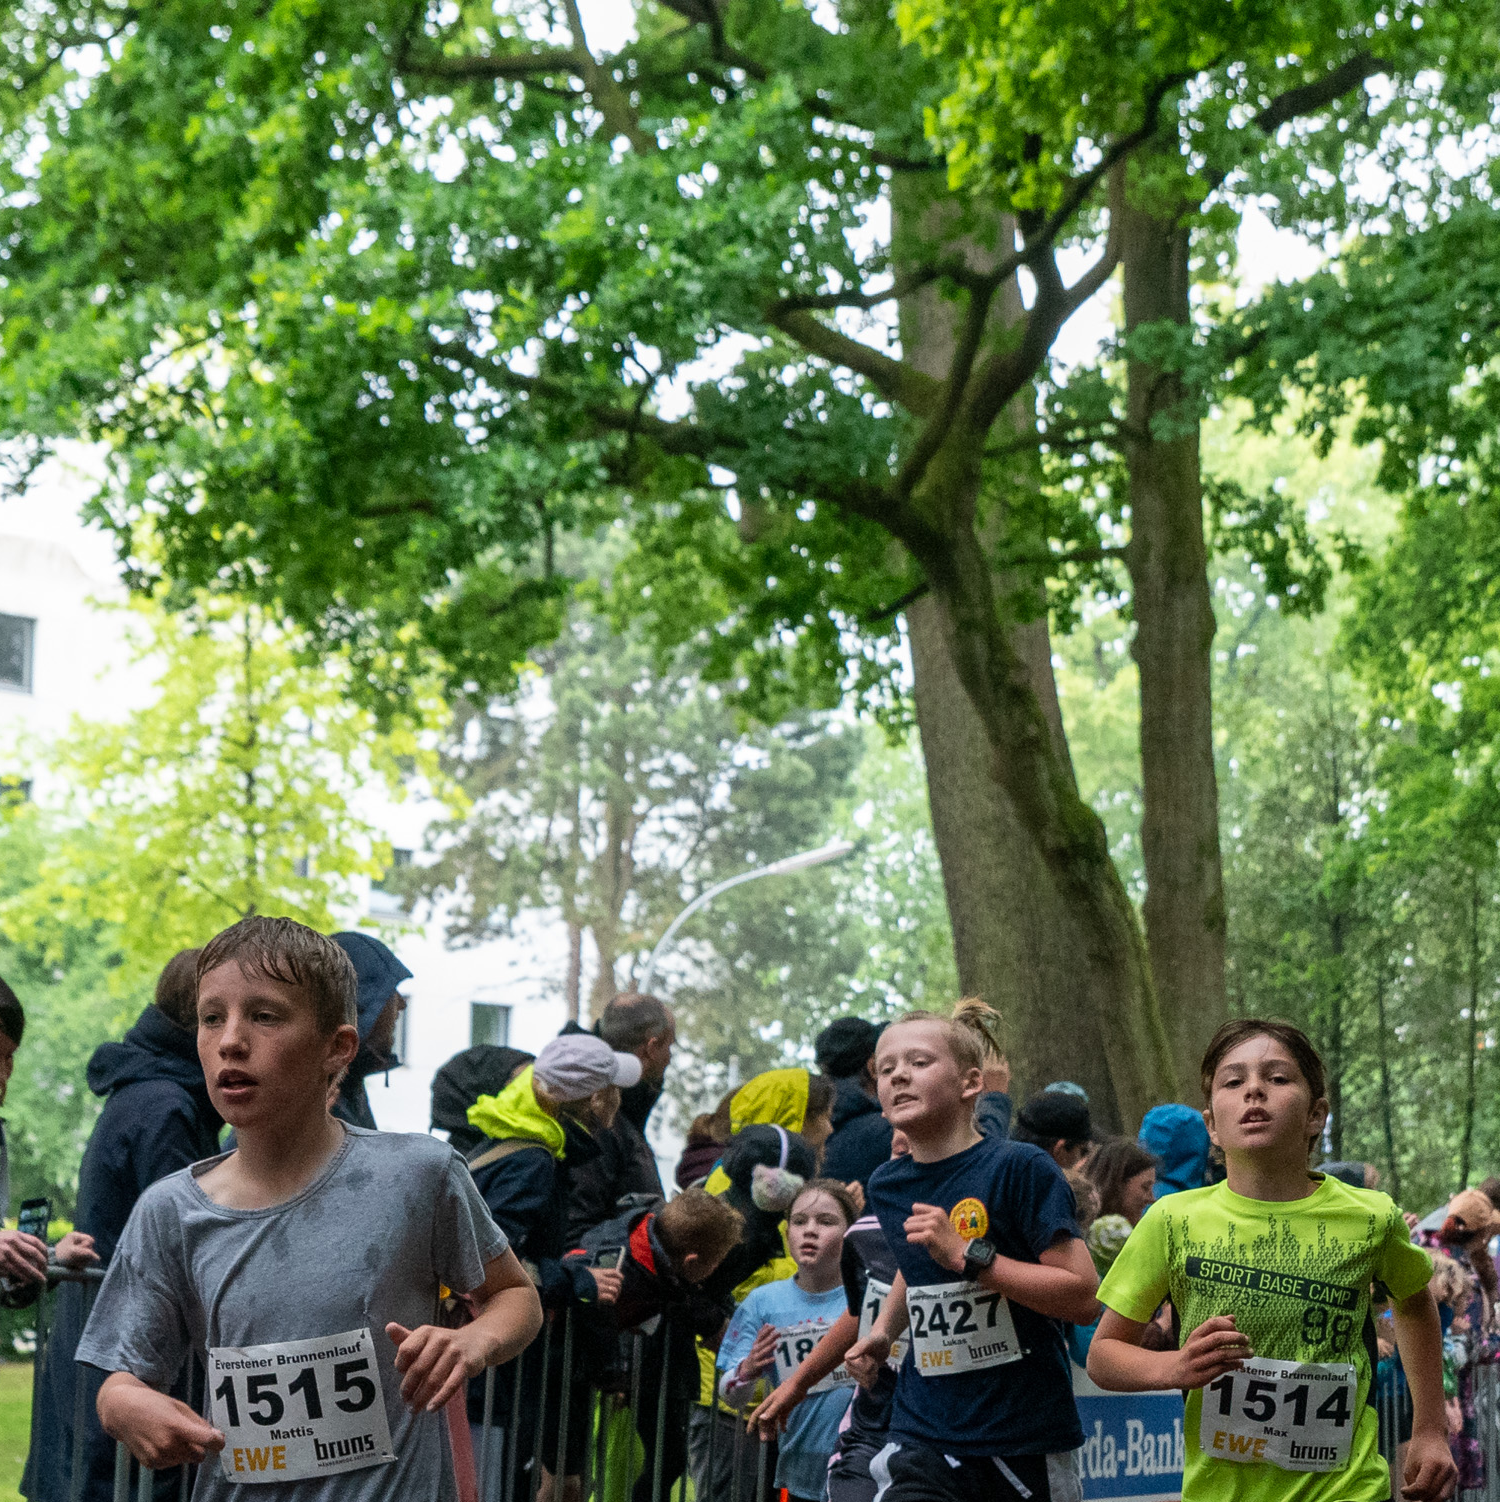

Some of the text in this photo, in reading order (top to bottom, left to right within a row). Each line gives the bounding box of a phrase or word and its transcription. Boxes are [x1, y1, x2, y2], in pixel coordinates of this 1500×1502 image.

[1199, 1261, 1352, 1306] SPORT BASE CAMP
[910, 1292, 1001, 1338] 2427
[215, 1341, 362, 1370] Everstener Brunnenlauf
[776, 1337, 824, 1368] 18
[921, 1350, 953, 1368] EWE
[968, 1340, 1009, 1359] bruns
[1236, 1364, 1348, 1382] stener Brunnenlauf
[215, 1358, 376, 1428] 1515
[1210, 1374, 1351, 1428] 1514
[270, 1426, 315, 1441] Mattis
[1212, 1430, 1338, 1460] EWE bruns
[1263, 1426, 1288, 1438] Max
[233, 1433, 375, 1472] EWE bruns
[1079, 1417, 1185, 1479] rda-Bank
